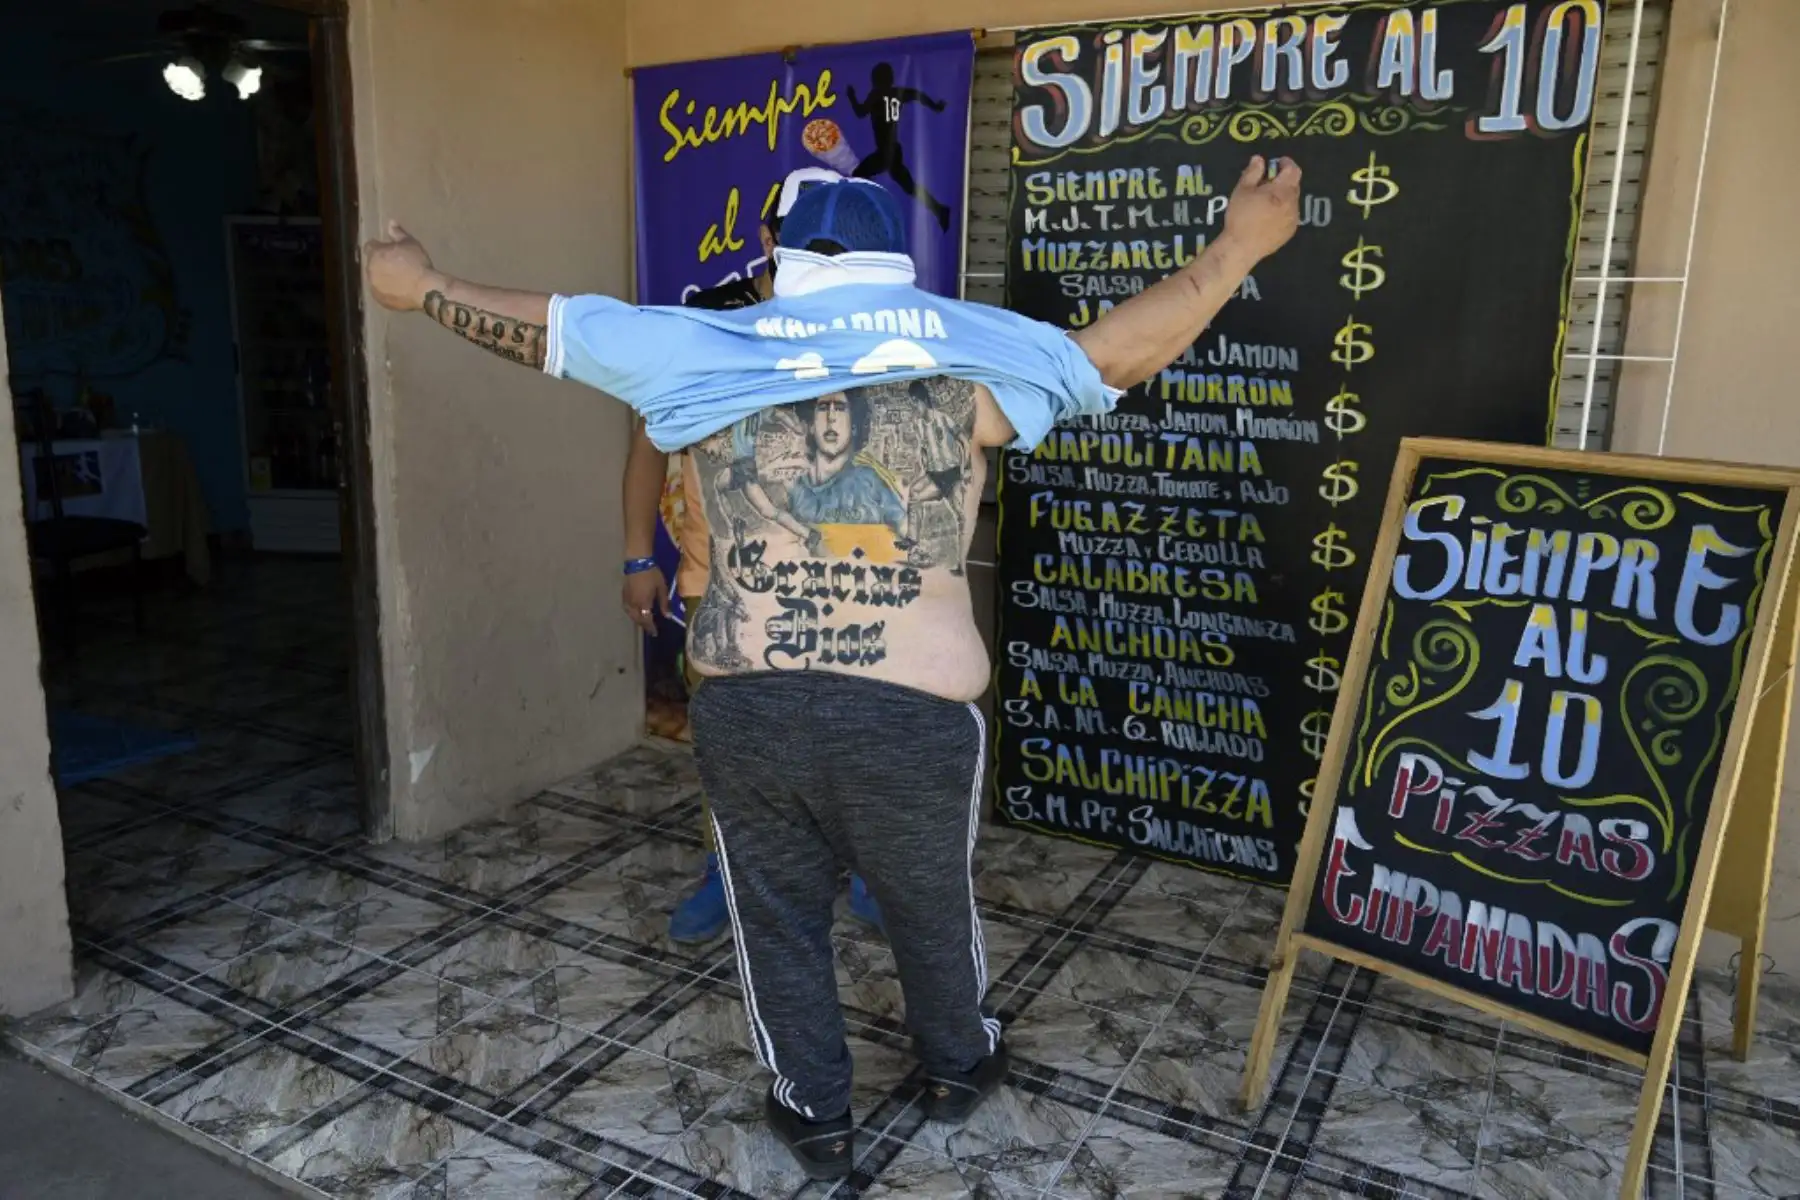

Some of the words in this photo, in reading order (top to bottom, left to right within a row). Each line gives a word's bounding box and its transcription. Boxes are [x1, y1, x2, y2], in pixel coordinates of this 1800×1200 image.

[1376, 4, 1455, 100] AL
[1472, 0, 1601, 134] 10
[659, 69, 836, 162] Siempre
[883, 96, 901, 122] 10
[1174, 164, 1213, 197] AL
[1347, 150, 1400, 220] $
[698, 187, 745, 263] al
[1339, 235, 1386, 301] $
[1208, 334, 1299, 372] JAMON
[1330, 313, 1375, 372] $
[1324, 382, 1367, 442] $
[1239, 479, 1290, 505] AJO
[1318, 456, 1360, 508] $
[1030, 490, 1266, 543] FUGAZZETA
[727, 537, 922, 608] Gracias
[1058, 532, 1142, 558] MUZZA
[1157, 535, 1266, 569] CEBOLLA
[1311, 522, 1356, 572] $
[1033, 553, 1259, 604] CALABRESA
[762, 594, 886, 671] Dios
[1308, 586, 1349, 636] $
[1050, 615, 1236, 667] ANCHOAS
[1514, 603, 1607, 685] AL
[1020, 669, 1043, 701] A
[1058, 673, 1099, 708] LA
[1128, 680, 1268, 740] CANCHA
[1164, 661, 1271, 698] ANCHOAS
[1160, 720, 1264, 762] RALLADO
[1466, 678, 1602, 789] 10
[1323, 806, 1680, 1033] EMPANADAS
